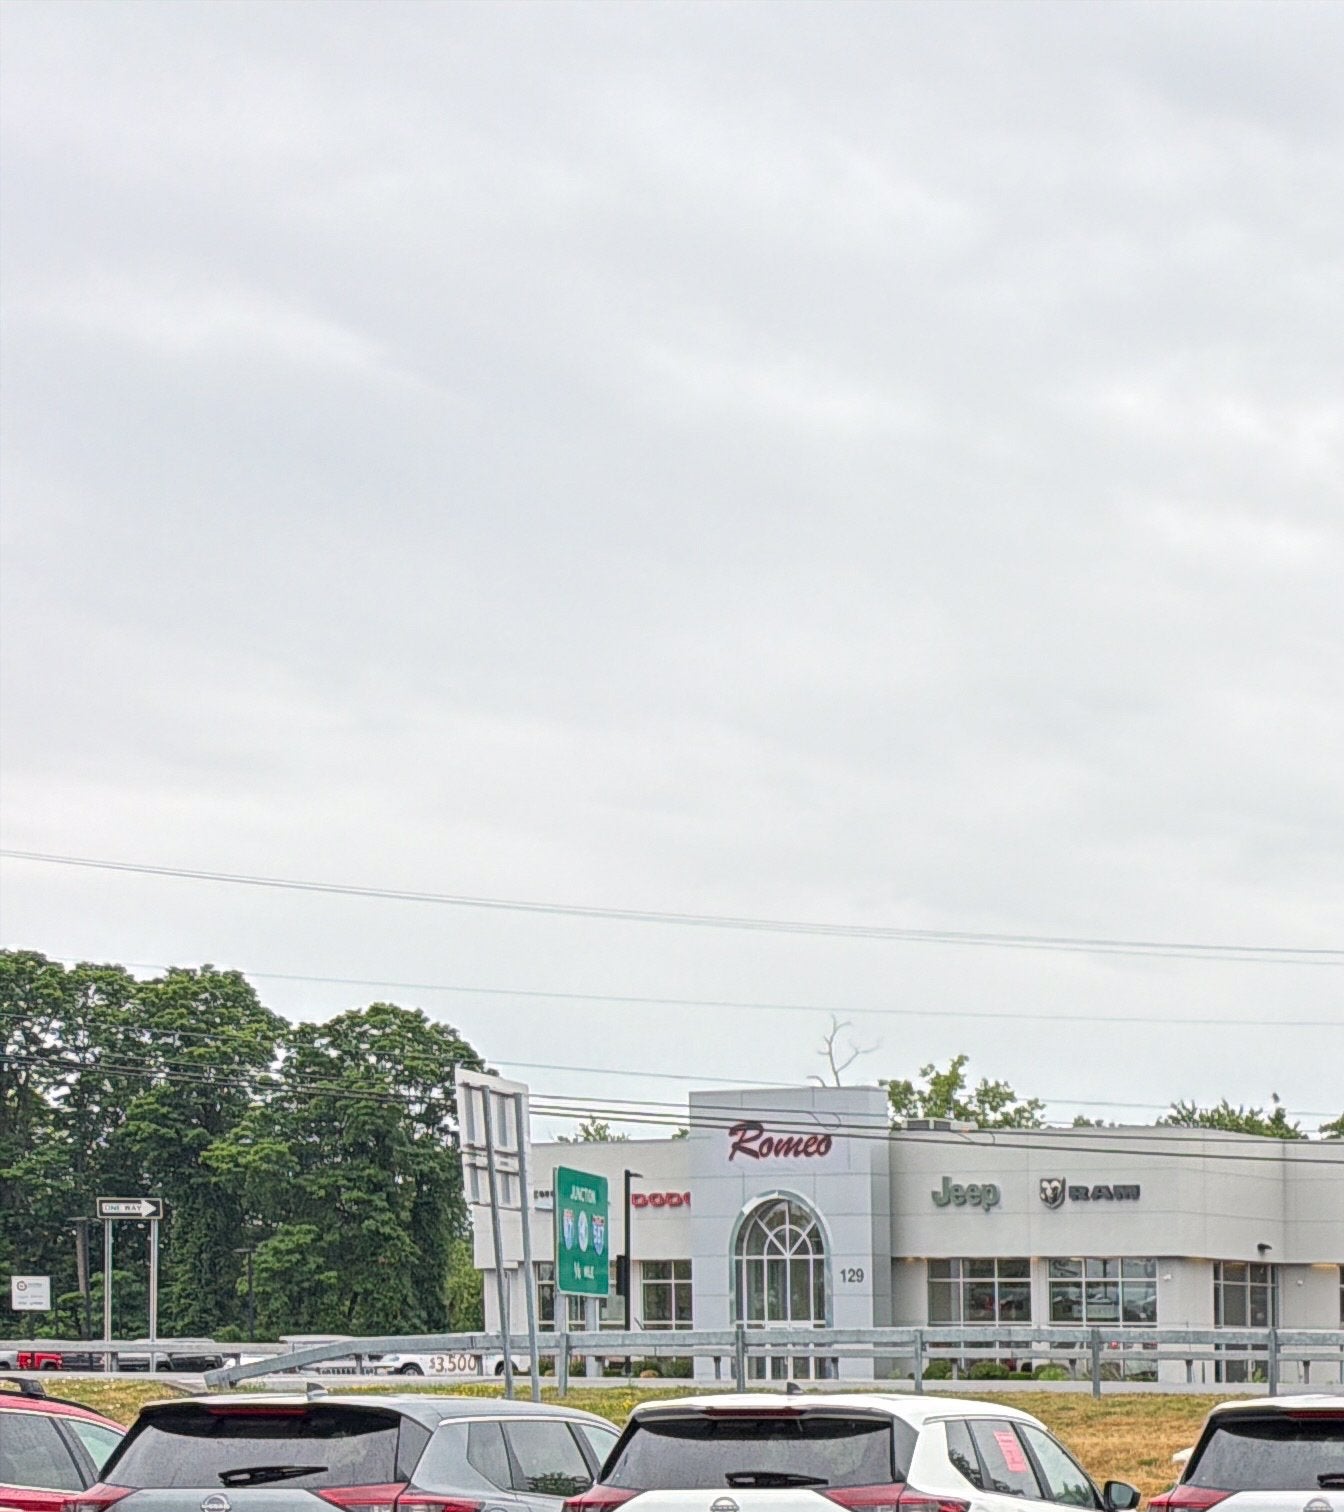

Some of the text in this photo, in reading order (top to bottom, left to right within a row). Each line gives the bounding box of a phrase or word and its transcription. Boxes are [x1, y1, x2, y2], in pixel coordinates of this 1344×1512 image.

[728, 1120, 833, 1161] Romeo
[931, 1176, 1001, 1212] Jeep
[1068, 1184, 1142, 1201] RAM
[124, 1204, 142, 1212] WAY
[839, 1267, 865, 1283] 129
[429, 1353, 477, 1373] $3,500
